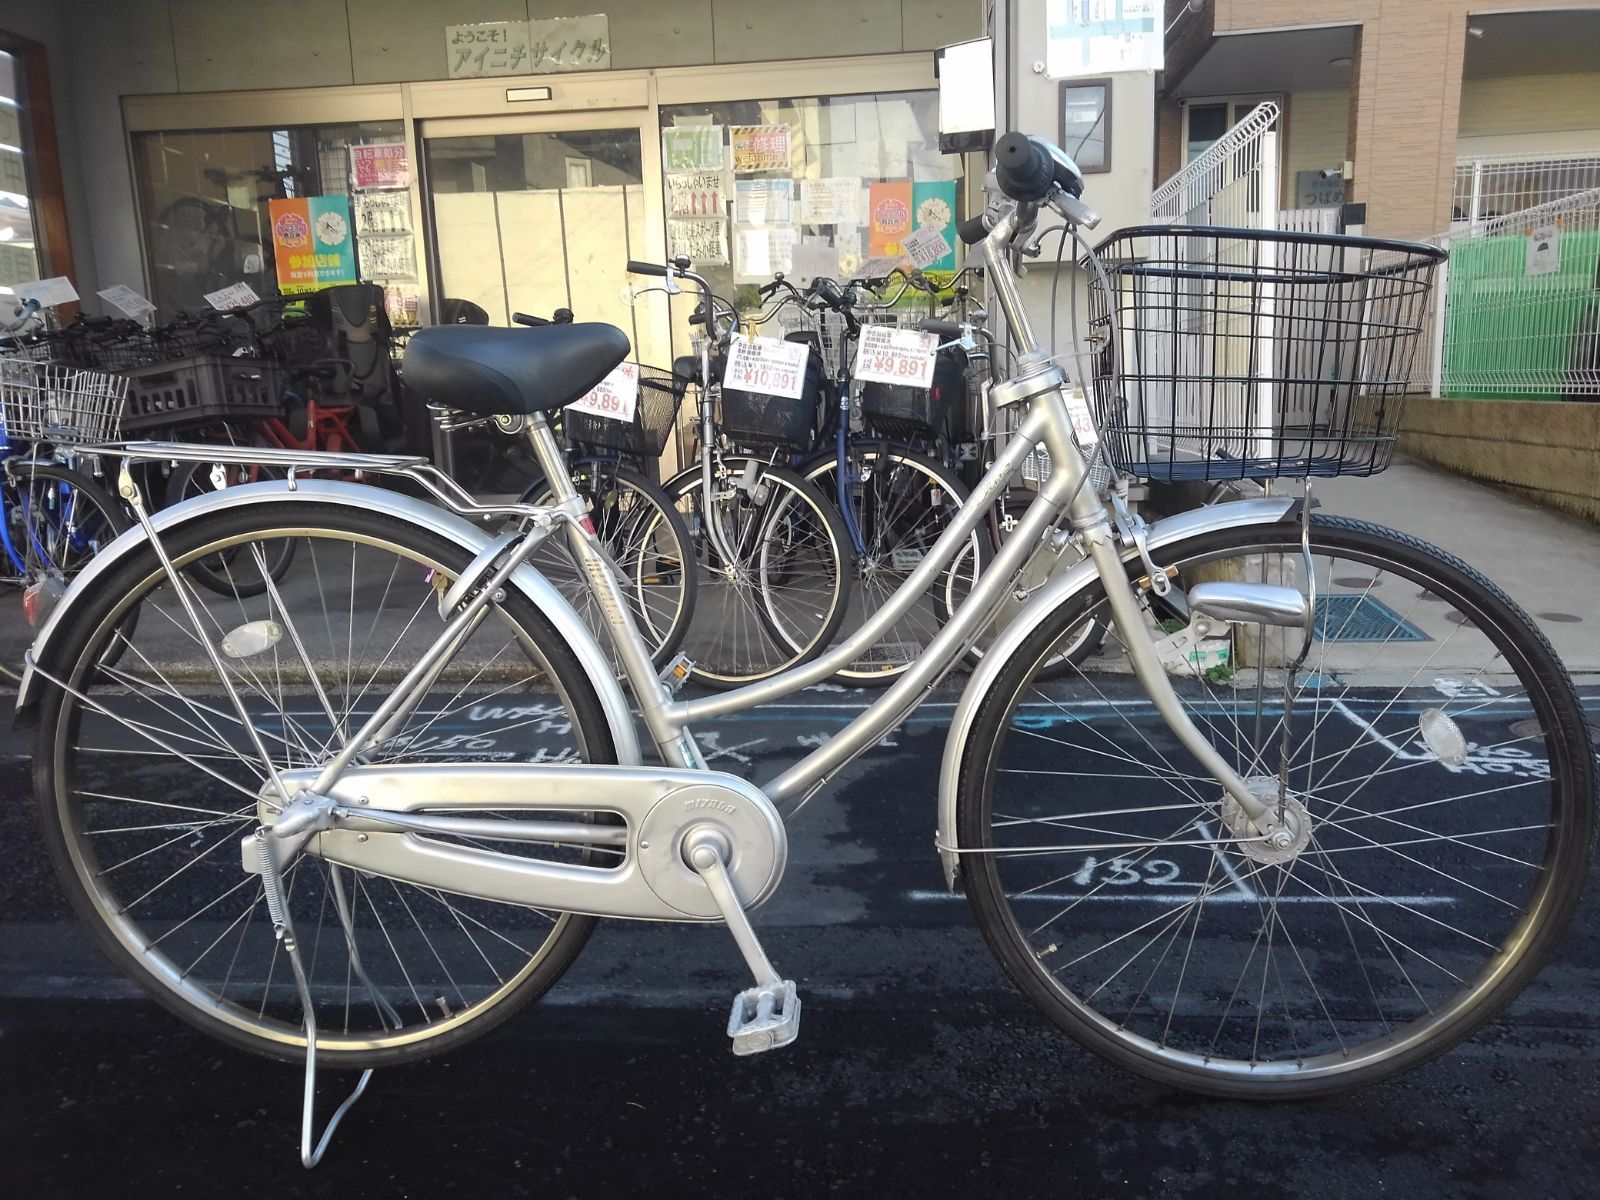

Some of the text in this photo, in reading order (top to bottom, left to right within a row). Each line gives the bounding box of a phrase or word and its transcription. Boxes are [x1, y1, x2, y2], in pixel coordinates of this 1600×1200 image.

[453, 38, 607, 72] アイニチサイクル
[668, 174, 720, 190] いらっしゃいませ
[743, 367, 798, 391] ¥10,891
[874, 356, 928, 378] ¥9,891
[1073, 856, 1181, 886] 152
